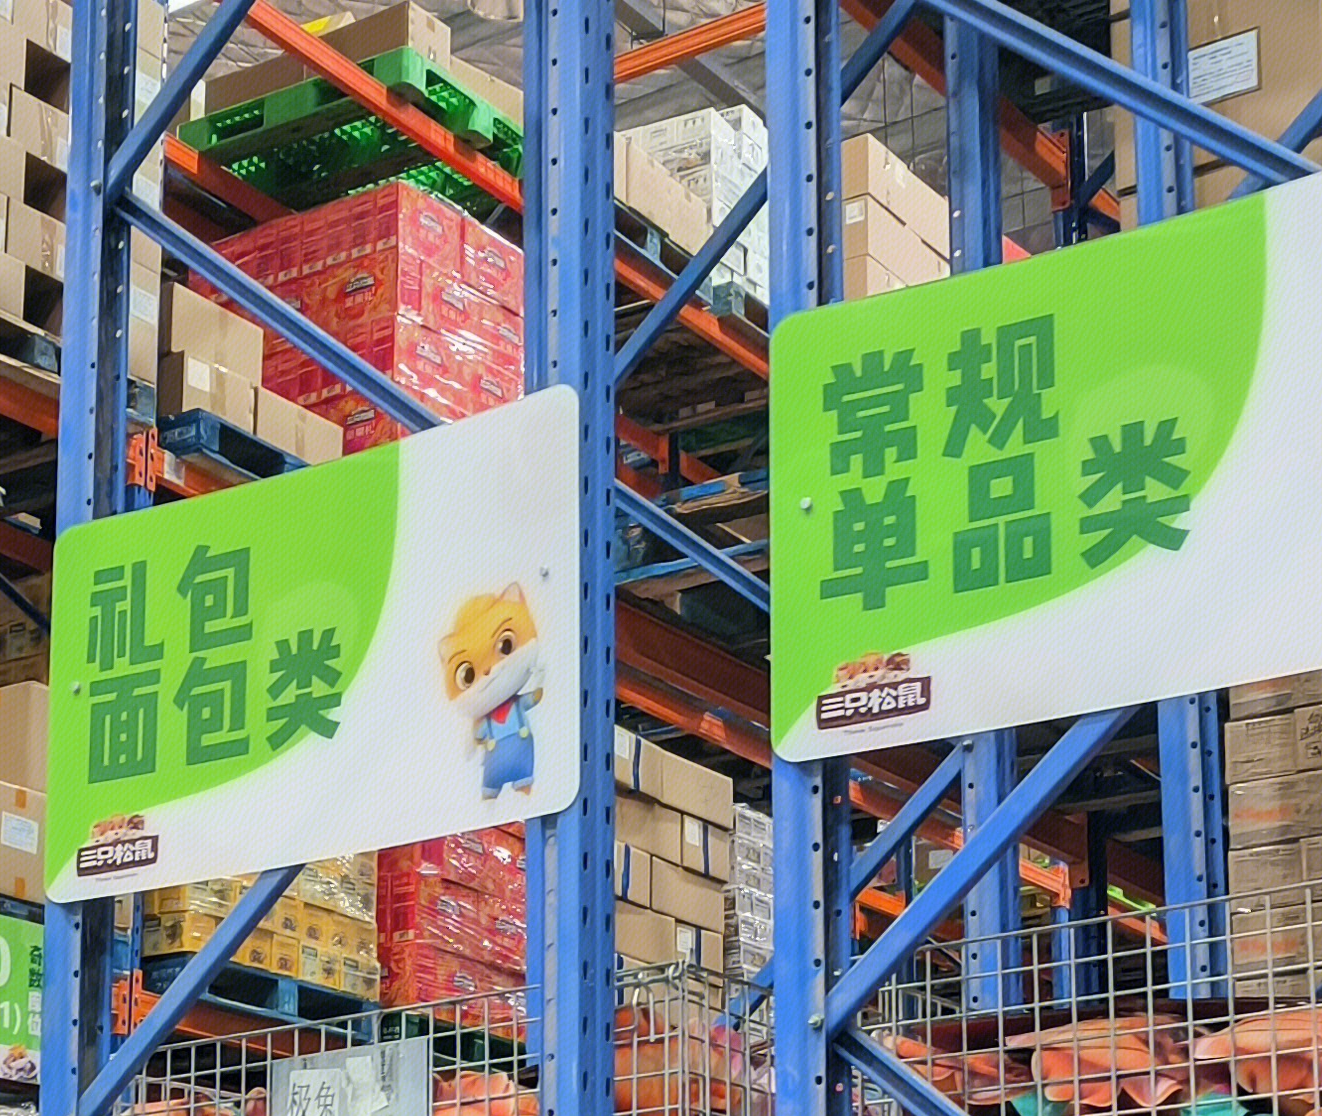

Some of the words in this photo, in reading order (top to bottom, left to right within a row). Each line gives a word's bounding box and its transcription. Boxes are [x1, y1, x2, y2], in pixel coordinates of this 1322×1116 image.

[822, 313, 1060, 479] 常规
[86, 544, 254, 672] 礼包
[820, 681, 927, 720] 三只松鼠
[79, 838, 155, 868] 三只松鼠
